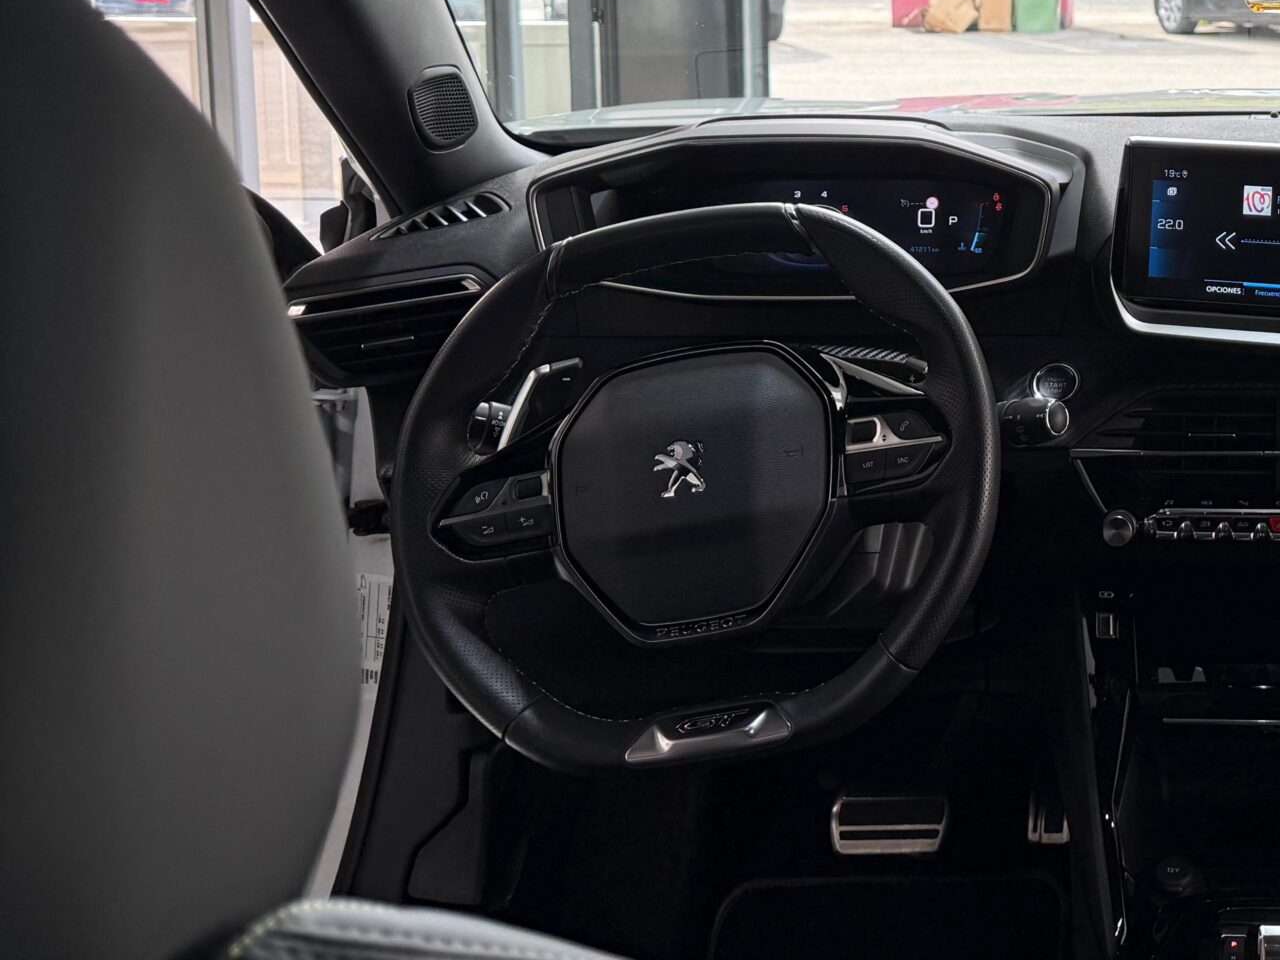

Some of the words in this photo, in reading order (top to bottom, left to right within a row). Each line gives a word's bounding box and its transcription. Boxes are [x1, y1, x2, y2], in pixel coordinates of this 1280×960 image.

[793, 190, 802, 198] 3
[820, 190, 828, 198] 4
[917, 208, 935, 228] 0
[948, 216, 958, 226] P
[1157, 218, 1184, 230] 22.0
[1206, 285, 1242, 295] OPCIONES
[656, 615, 747, 637] PEUGEOT
